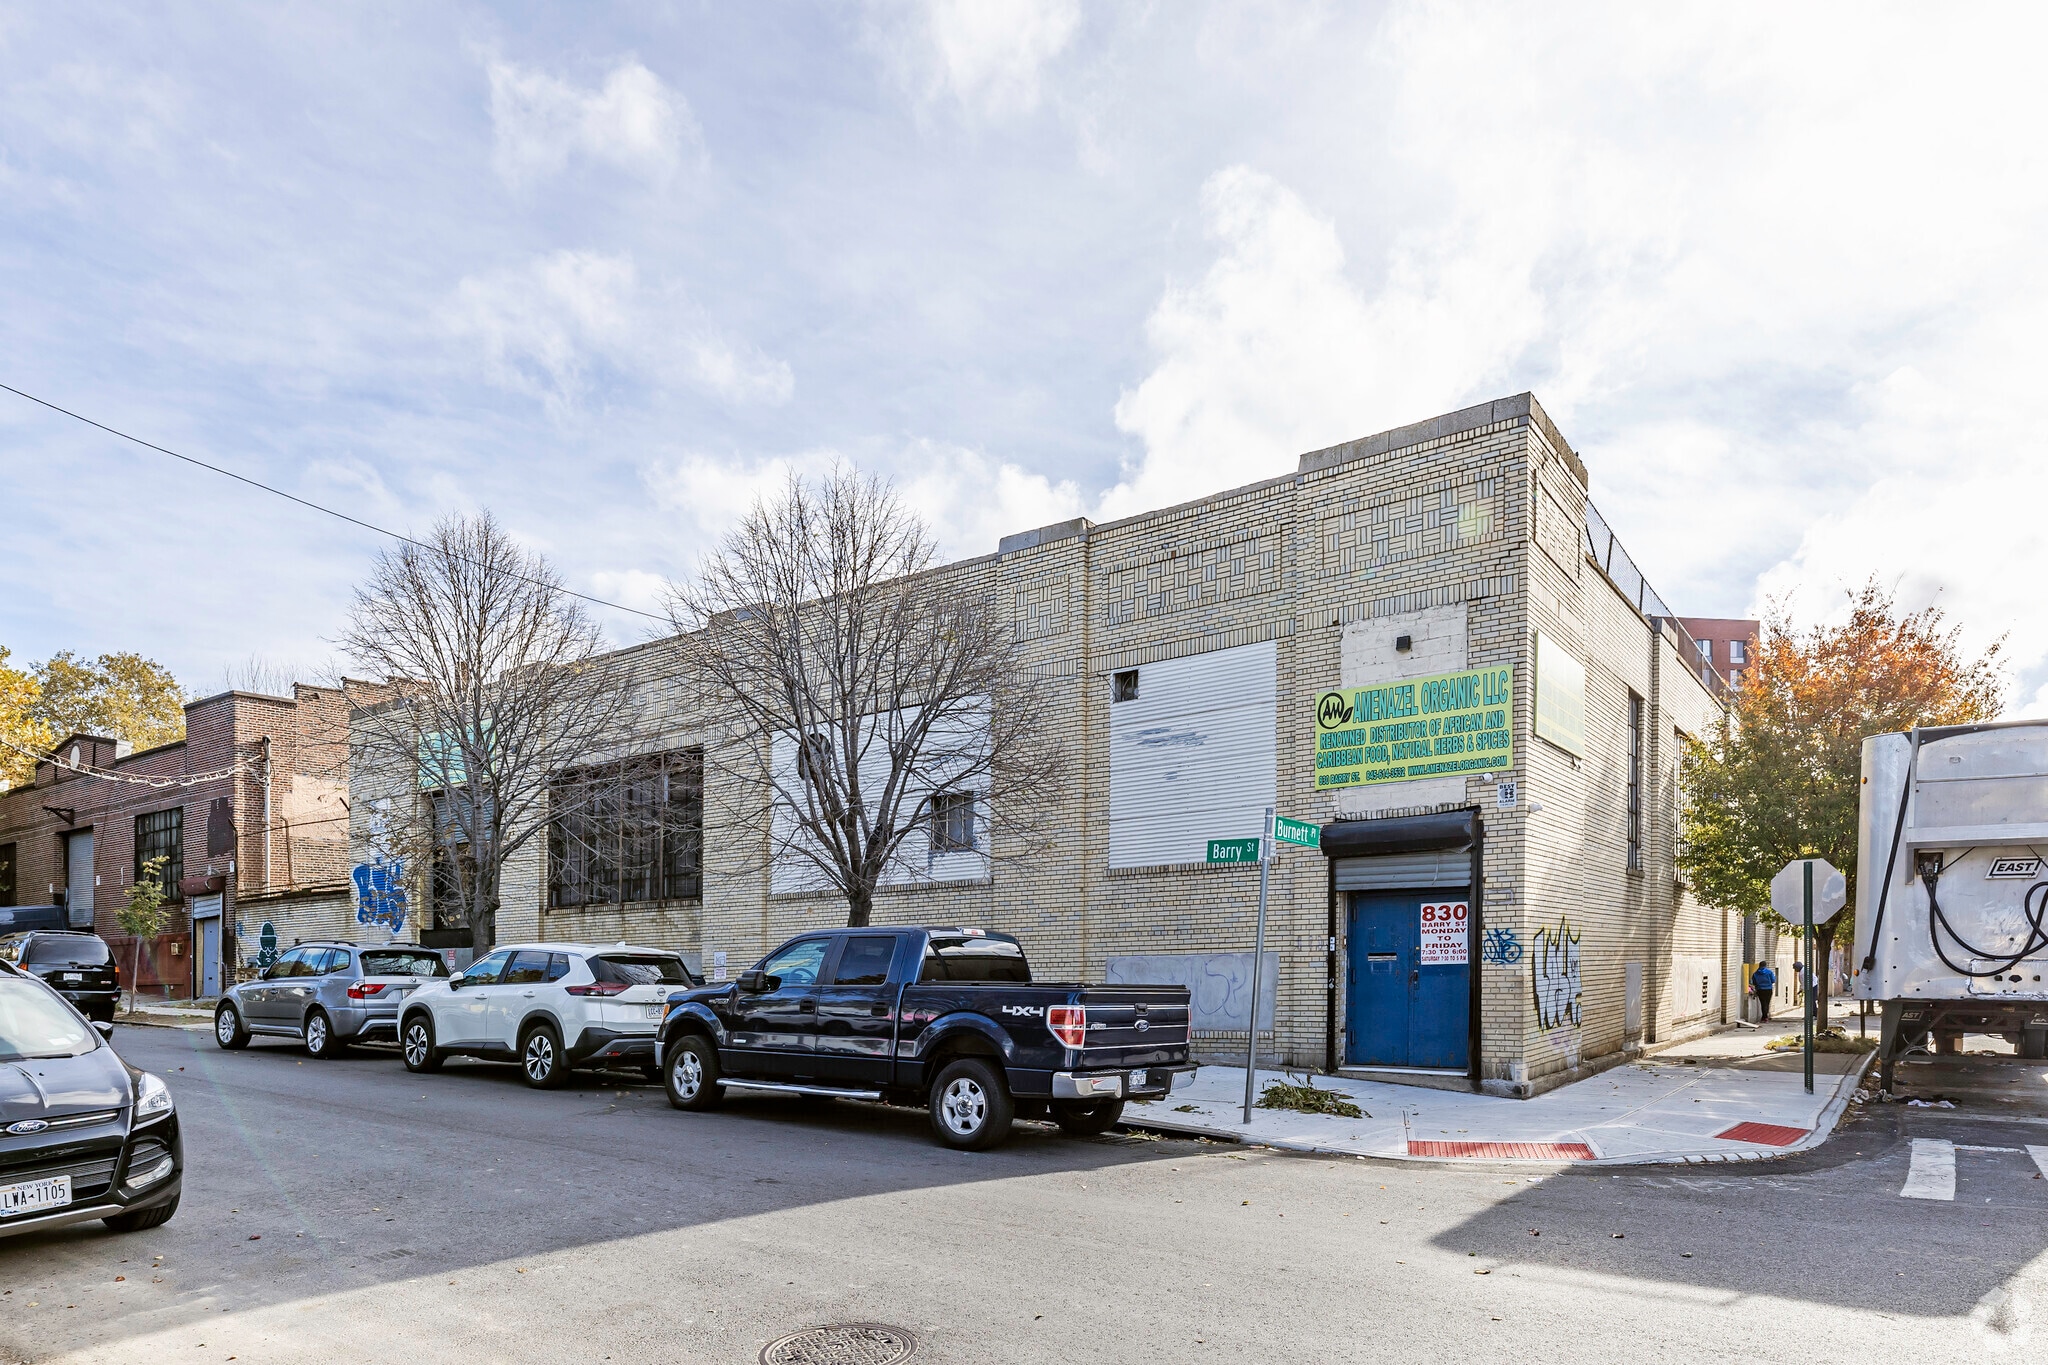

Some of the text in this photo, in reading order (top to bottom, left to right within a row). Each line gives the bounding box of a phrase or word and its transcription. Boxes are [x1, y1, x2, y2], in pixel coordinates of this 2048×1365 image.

[1353, 670, 1508, 723] AMENAZEL ORGANIC LLC
[1319, 710, 1505, 750] RENOWNED DISTRIBUTOR OF AFRICAN AND
[1316, 729, 1510, 769] CARIBBEAN FOOD, NATURAL HERBS & SPICES
[1330, 772, 1351, 785] BARRY
[1407, 755, 1508, 776] WWW.AMENAZELORGANIC.COM
[1277, 820, 1317, 842] Burnett Pl
[1212, 842, 1255, 861] Barry St
[1996, 863, 2035, 871] EAST
[1421, 904, 1467, 921] 830
[34, 1180, 53, 1188] YORK
